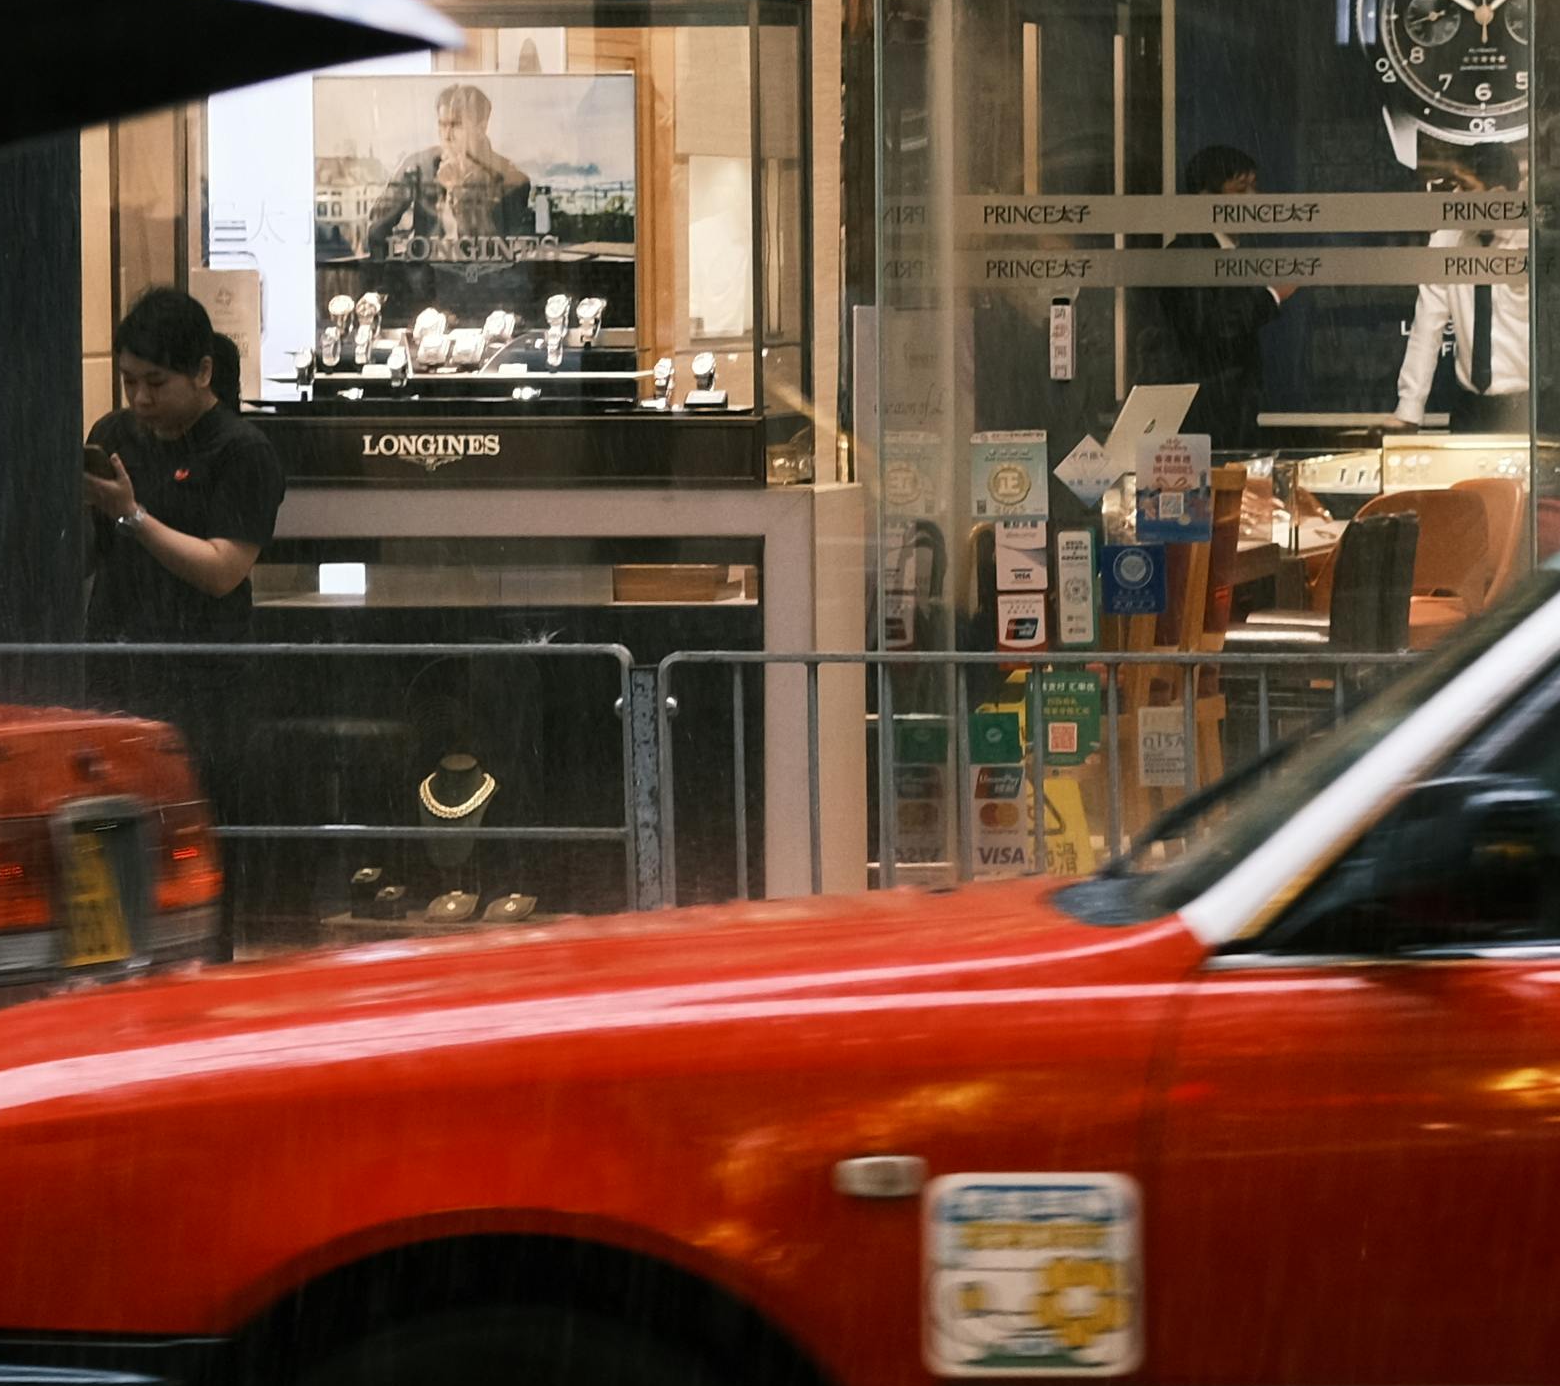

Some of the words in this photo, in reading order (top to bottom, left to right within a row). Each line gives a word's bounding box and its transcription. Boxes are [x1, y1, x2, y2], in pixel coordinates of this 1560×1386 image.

[1474, 82, 1492, 101] 6
[982, 204, 1092, 224] PRINCE太子
[1211, 202, 1320, 224] PRINCE太子
[384, 234, 561, 264] LONGINES
[985, 258, 1093, 279] PRINCE太子
[1213, 257, 1323, 278] PRINCE太子
[362, 433, 501, 457] LONGINES
[976, 846, 1026, 865] VISA
